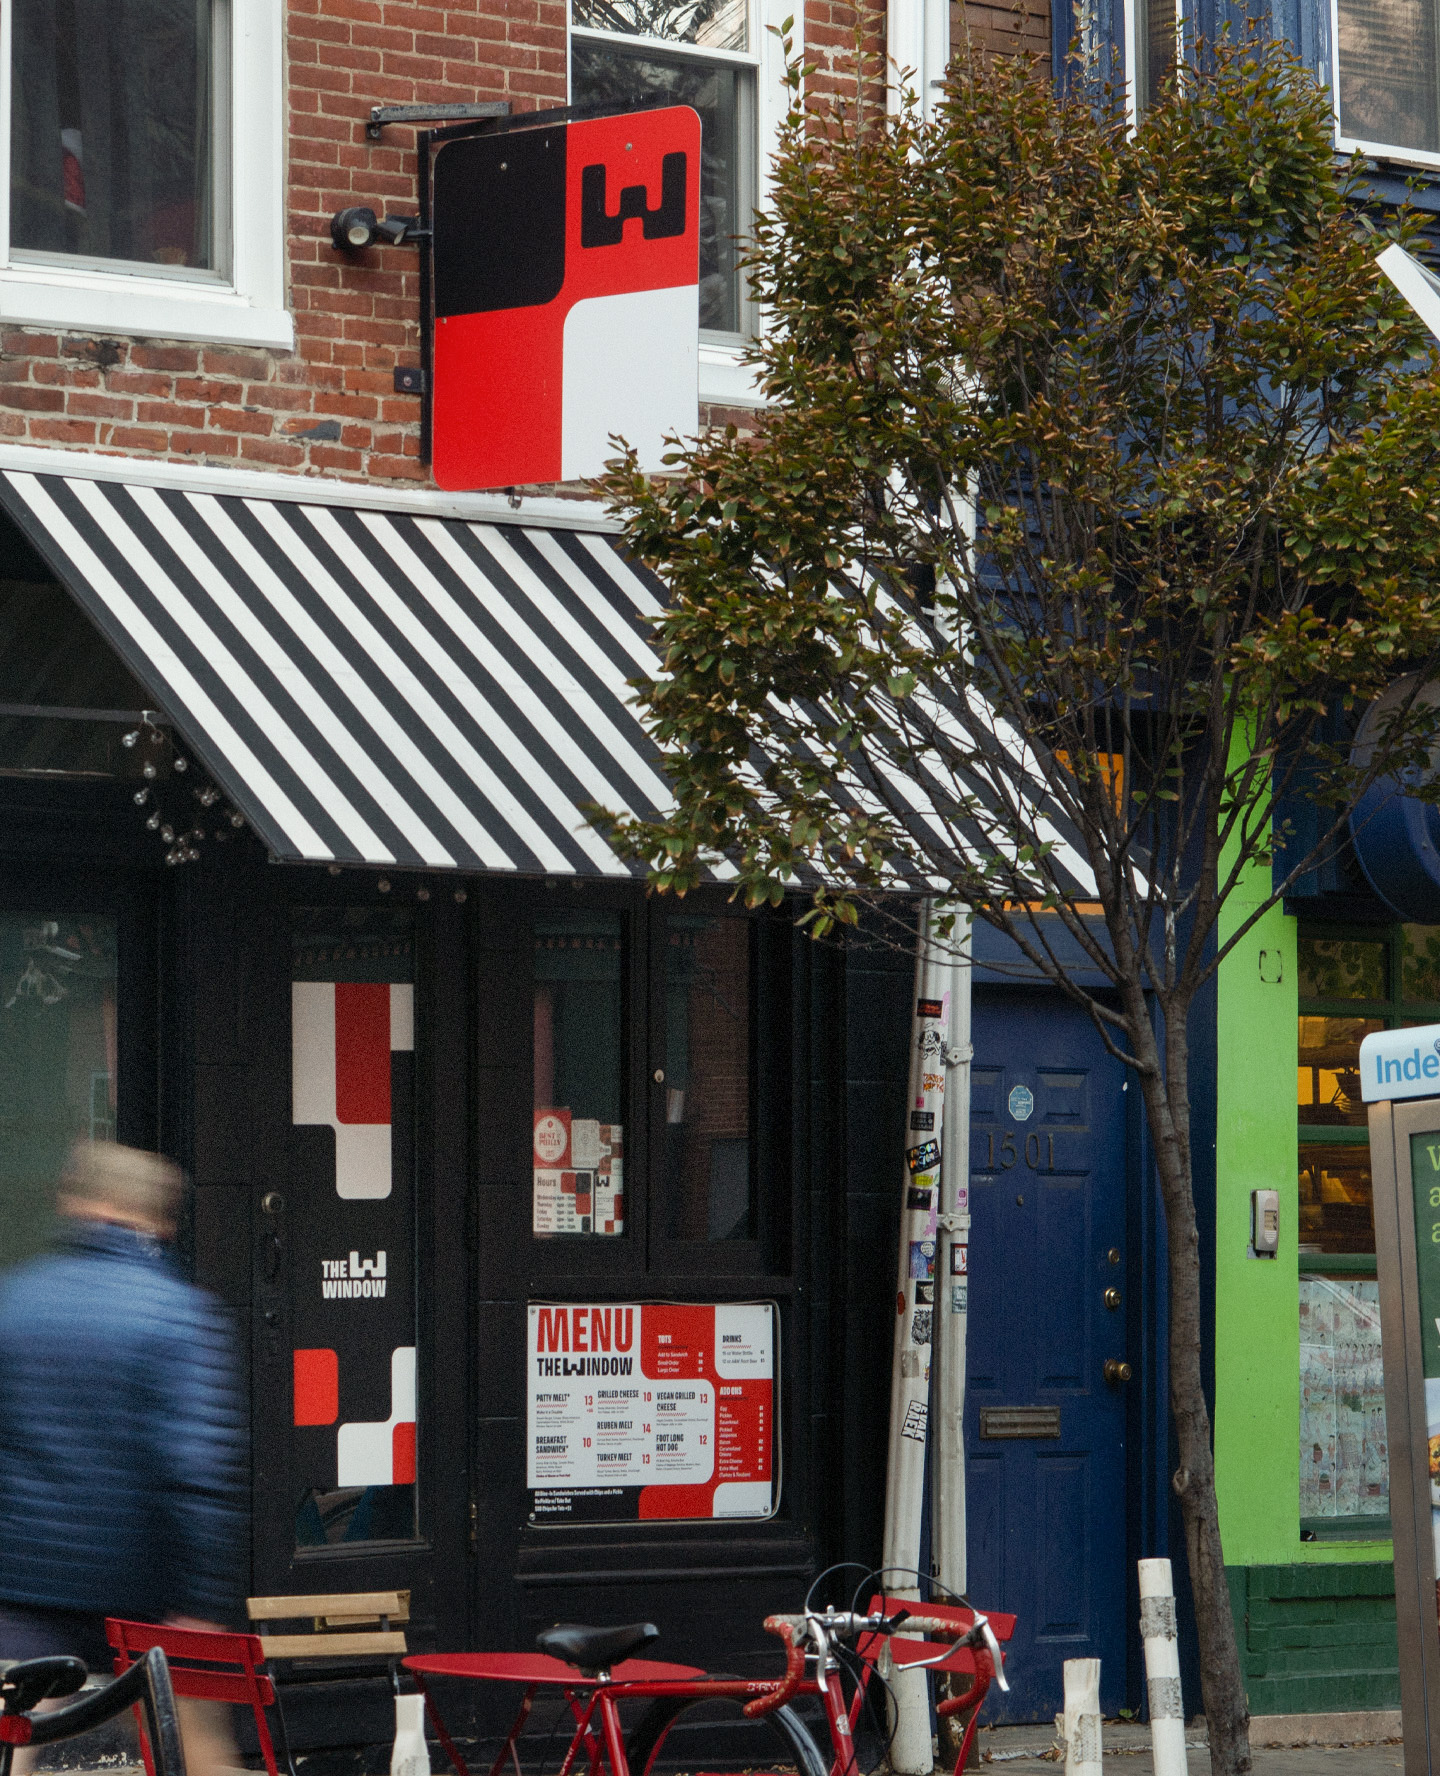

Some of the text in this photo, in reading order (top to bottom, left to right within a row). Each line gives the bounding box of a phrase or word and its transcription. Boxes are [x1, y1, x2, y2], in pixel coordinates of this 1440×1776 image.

[581, 152, 687, 249] W
[988, 1132, 1054, 1170] 1501
[537, 1176, 557, 1187] Hours
[321, 1250, 387, 1278] THE W
[321, 1280, 387, 1298] WINDOW
[537, 1308, 633, 1352] MENU
[658, 1335, 672, 1344] TOTS
[722, 1335, 742, 1343] DRINKS
[537, 1358, 561, 1376] THE
[597, 1390, 639, 1398] GRILLED CHEESE
[656, 1391, 695, 1400] VEGAN GRILLED
[719, 1387, 742, 1395] ADD ONS
[536, 1394, 551, 1402] PATTY
[584, 1395, 593, 1406] 13
[643, 1392, 652, 1402] 10
[700, 1393, 708, 1404] 13
[656, 1403, 677, 1411] CHEESE
[597, 1421, 633, 1430] REUBEN MELT
[642, 1423, 651, 1434] 14
[536, 1436, 567, 1444] BREAKFAST
[583, 1437, 592, 1448] 10
[656, 1434, 684, 1442] FOOT LONG
[699, 1434, 707, 1445] 12
[656, 1443, 678, 1452] HOT DOG
[597, 1453, 632, 1462] TURKEY MELT
[642, 1453, 650, 1464] 13
